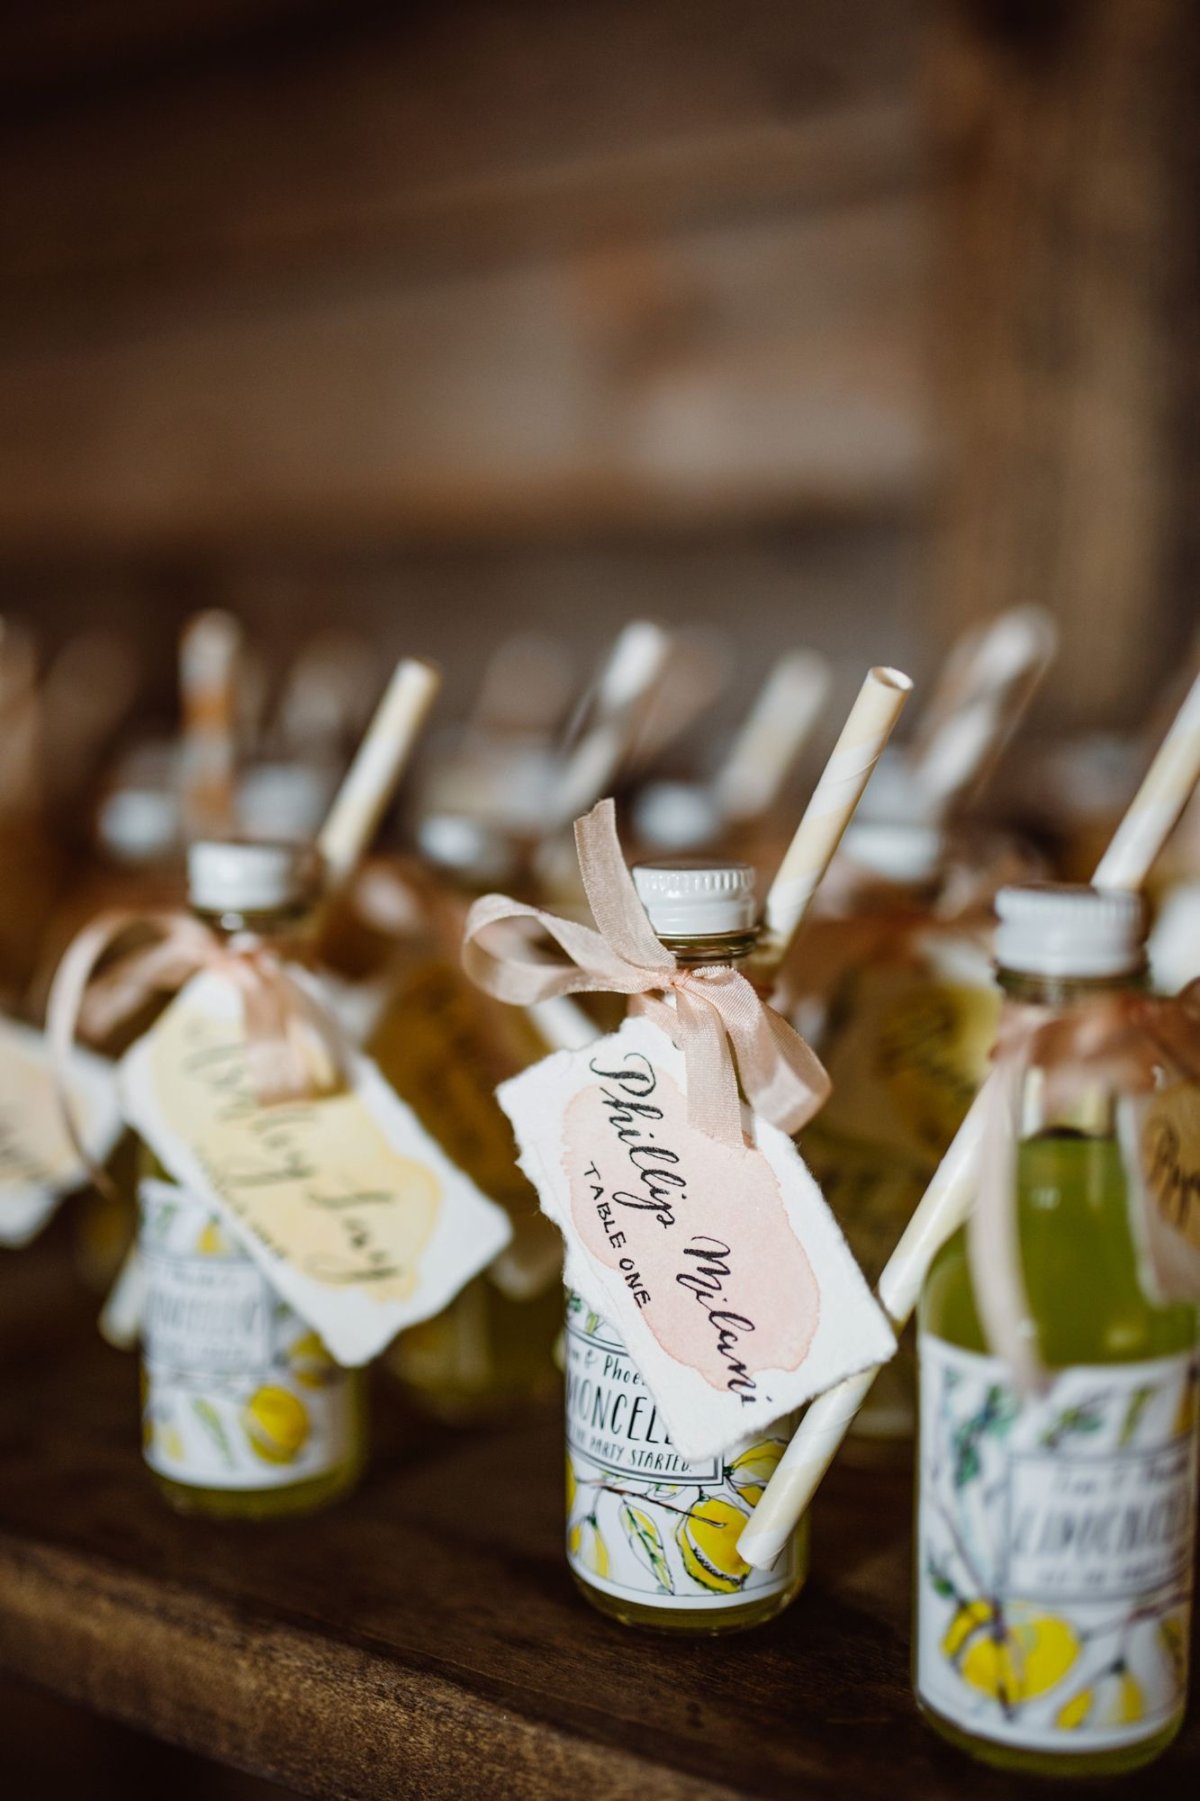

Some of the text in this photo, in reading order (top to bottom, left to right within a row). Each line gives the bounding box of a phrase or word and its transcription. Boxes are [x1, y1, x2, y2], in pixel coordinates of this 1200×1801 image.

[584, 1161, 651, 1309] TABLE ONE
[589, 1053, 773, 1407] Phillip Milani
[567, 1374, 673, 1445] ONCEL
[603, 1354, 646, 1386] Phoe
